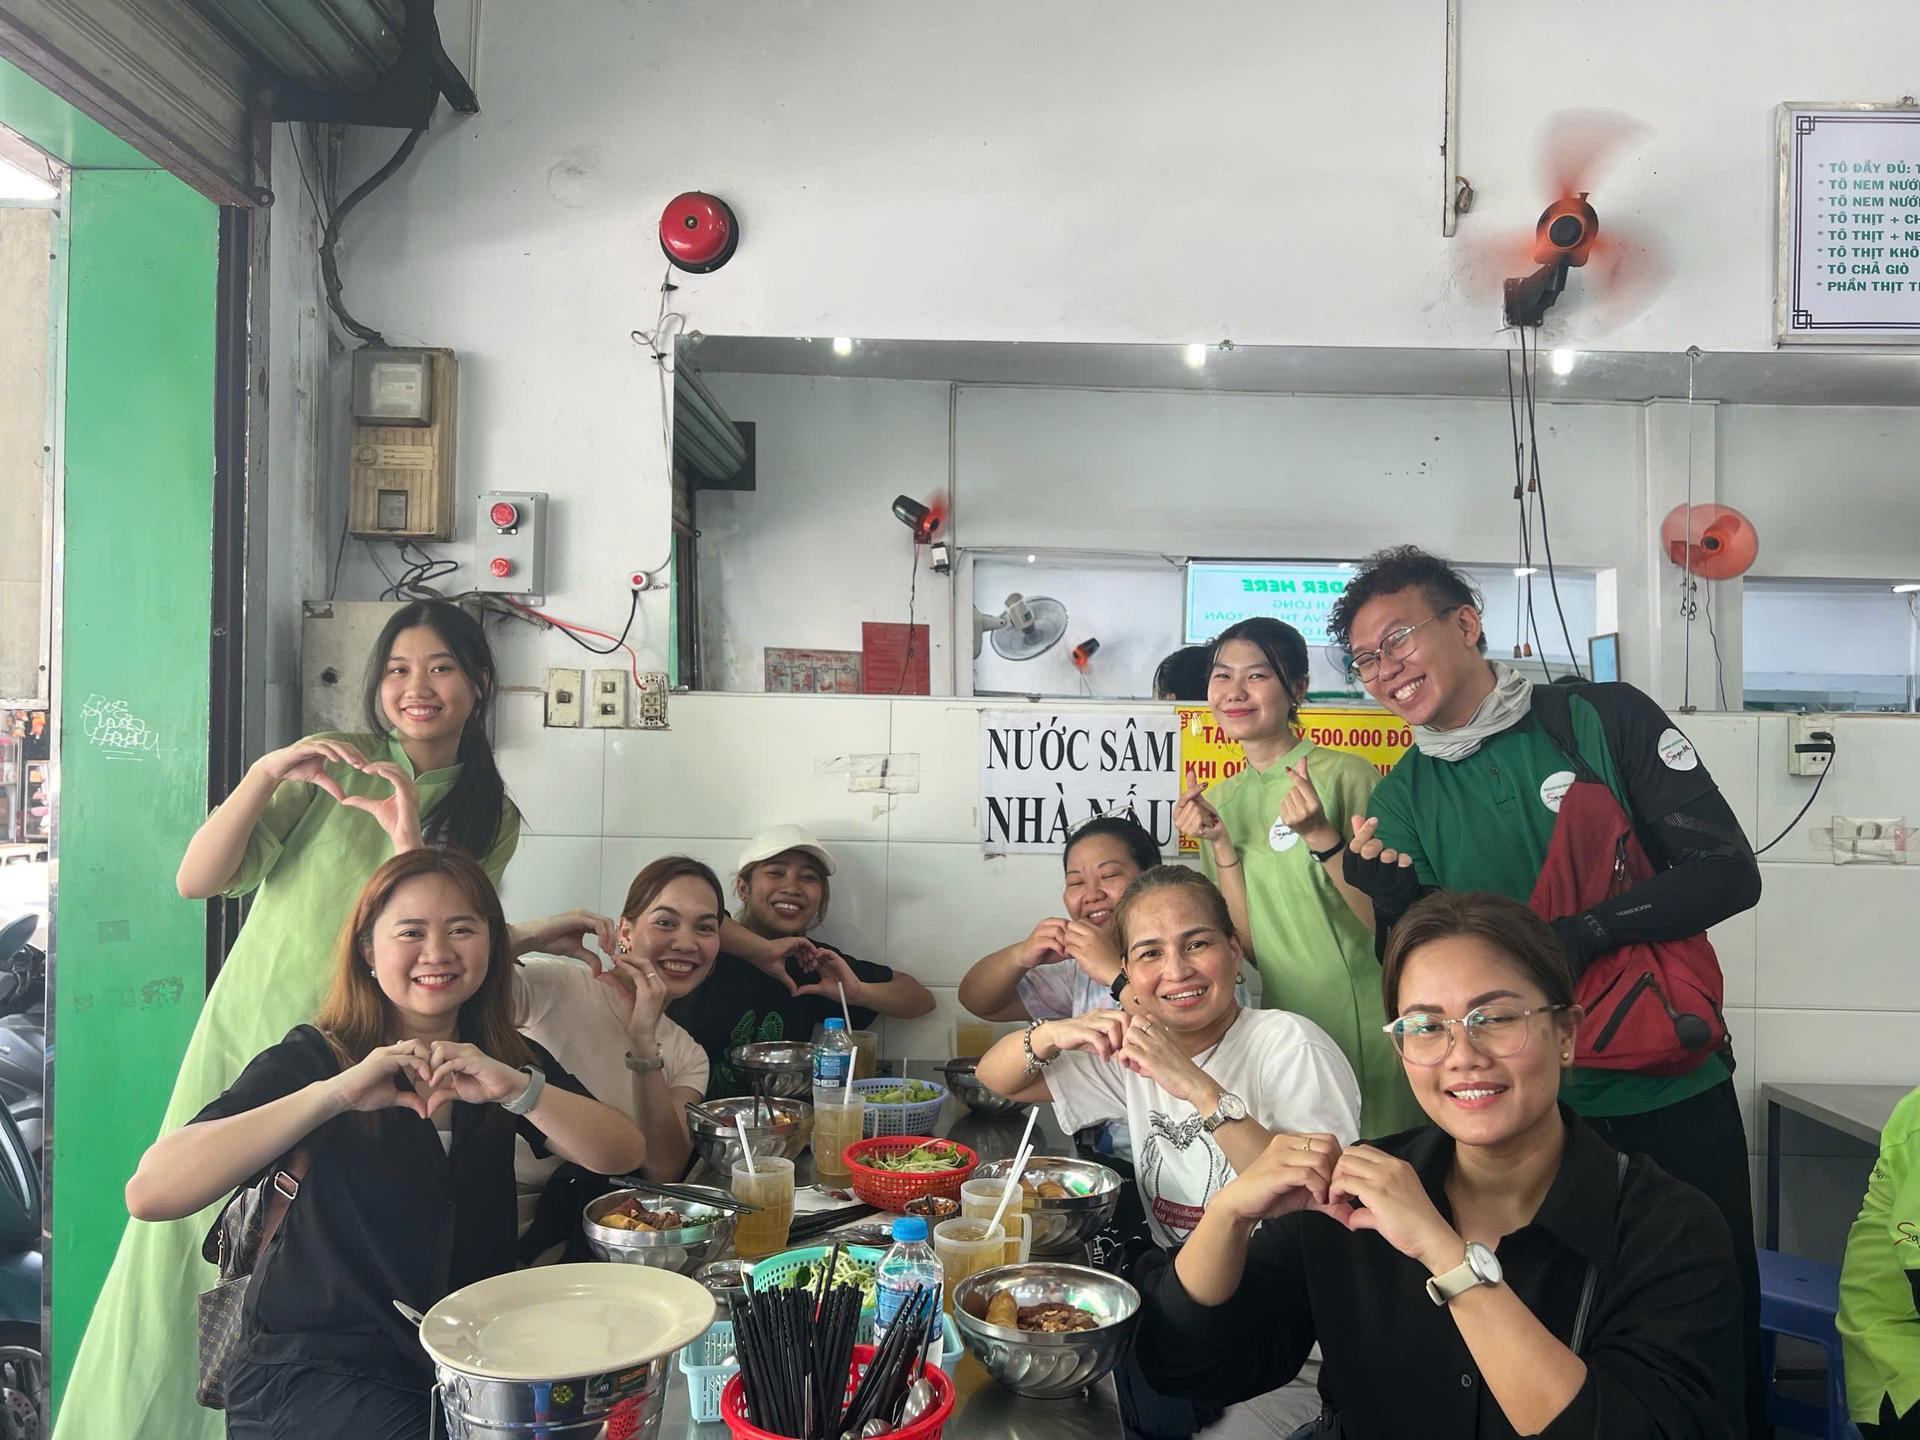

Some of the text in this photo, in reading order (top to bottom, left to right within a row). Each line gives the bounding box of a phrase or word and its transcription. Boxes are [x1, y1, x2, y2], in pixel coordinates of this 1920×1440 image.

[1828, 160, 1848, 173] TÔ
[1886, 160, 1911, 174] ĐỦ:
[1828, 177, 1920, 191] TÔ NEM NƯỚ
[1828, 194, 1920, 208] TÔ NEM NƯỚ
[1828, 211, 1848, 224] TÔ
[1851, 213, 1884, 226] THỊT
[1828, 228, 1847, 240] TÔ
[1851, 230, 1884, 242] THỊT
[1827, 245, 1847, 257] TÔ
[1851, 247, 1884, 260] THỊT
[1827, 261, 1909, 275] TÔ CHẢ GIÒ
[1871, 281, 1904, 294] THỊT
[986, 716, 1176, 772] NƯỚC SÂM
[1311, 728, 1382, 747] 500.000
[985, 783, 1071, 843] NHÀ
